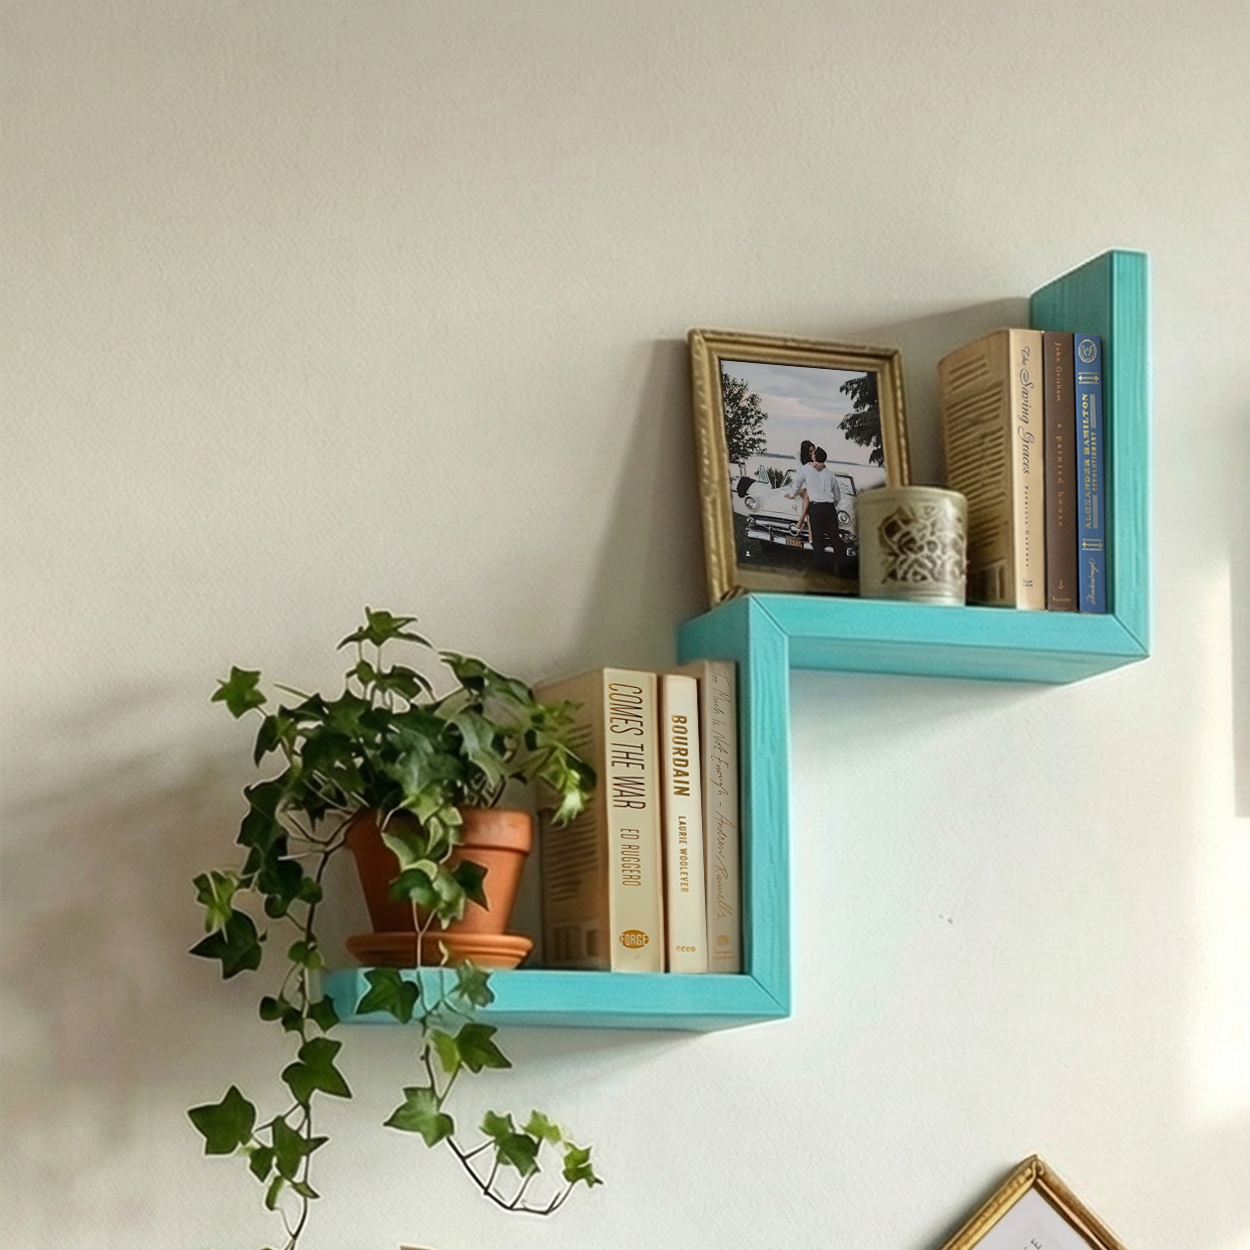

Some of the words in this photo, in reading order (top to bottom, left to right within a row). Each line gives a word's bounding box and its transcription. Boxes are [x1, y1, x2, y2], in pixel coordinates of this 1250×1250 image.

[1020, 345, 1031, 367] The
[1054, 341, 1062, 363] John
[1017, 368, 1035, 424] Saving
[1082, 393, 1091, 455] HAMILTON
[1017, 425, 1036, 475] Graces
[1055, 435, 1064, 484] painted
[1057, 491, 1065, 527] house
[1084, 459, 1092, 529] ALEXANDER
[608, 682, 645, 736] COMES
[708, 686, 731, 715] Much
[610, 742, 645, 770] THE
[671, 714, 691, 797] BOURDAIN
[710, 729, 731, 755] Not
[612, 776, 646, 810] WAR
[708, 755, 729, 796] Enough
[620, 828, 640, 840] ED
[677, 815, 688, 845] LAURIE
[714, 810, 736, 859] Andrew
[621, 844, 642, 887] RUGGERO
[679, 848, 689, 893] WOOLEVER
[620, 933, 649, 946] FORGE
[675, 945, 696, 953] ecco
